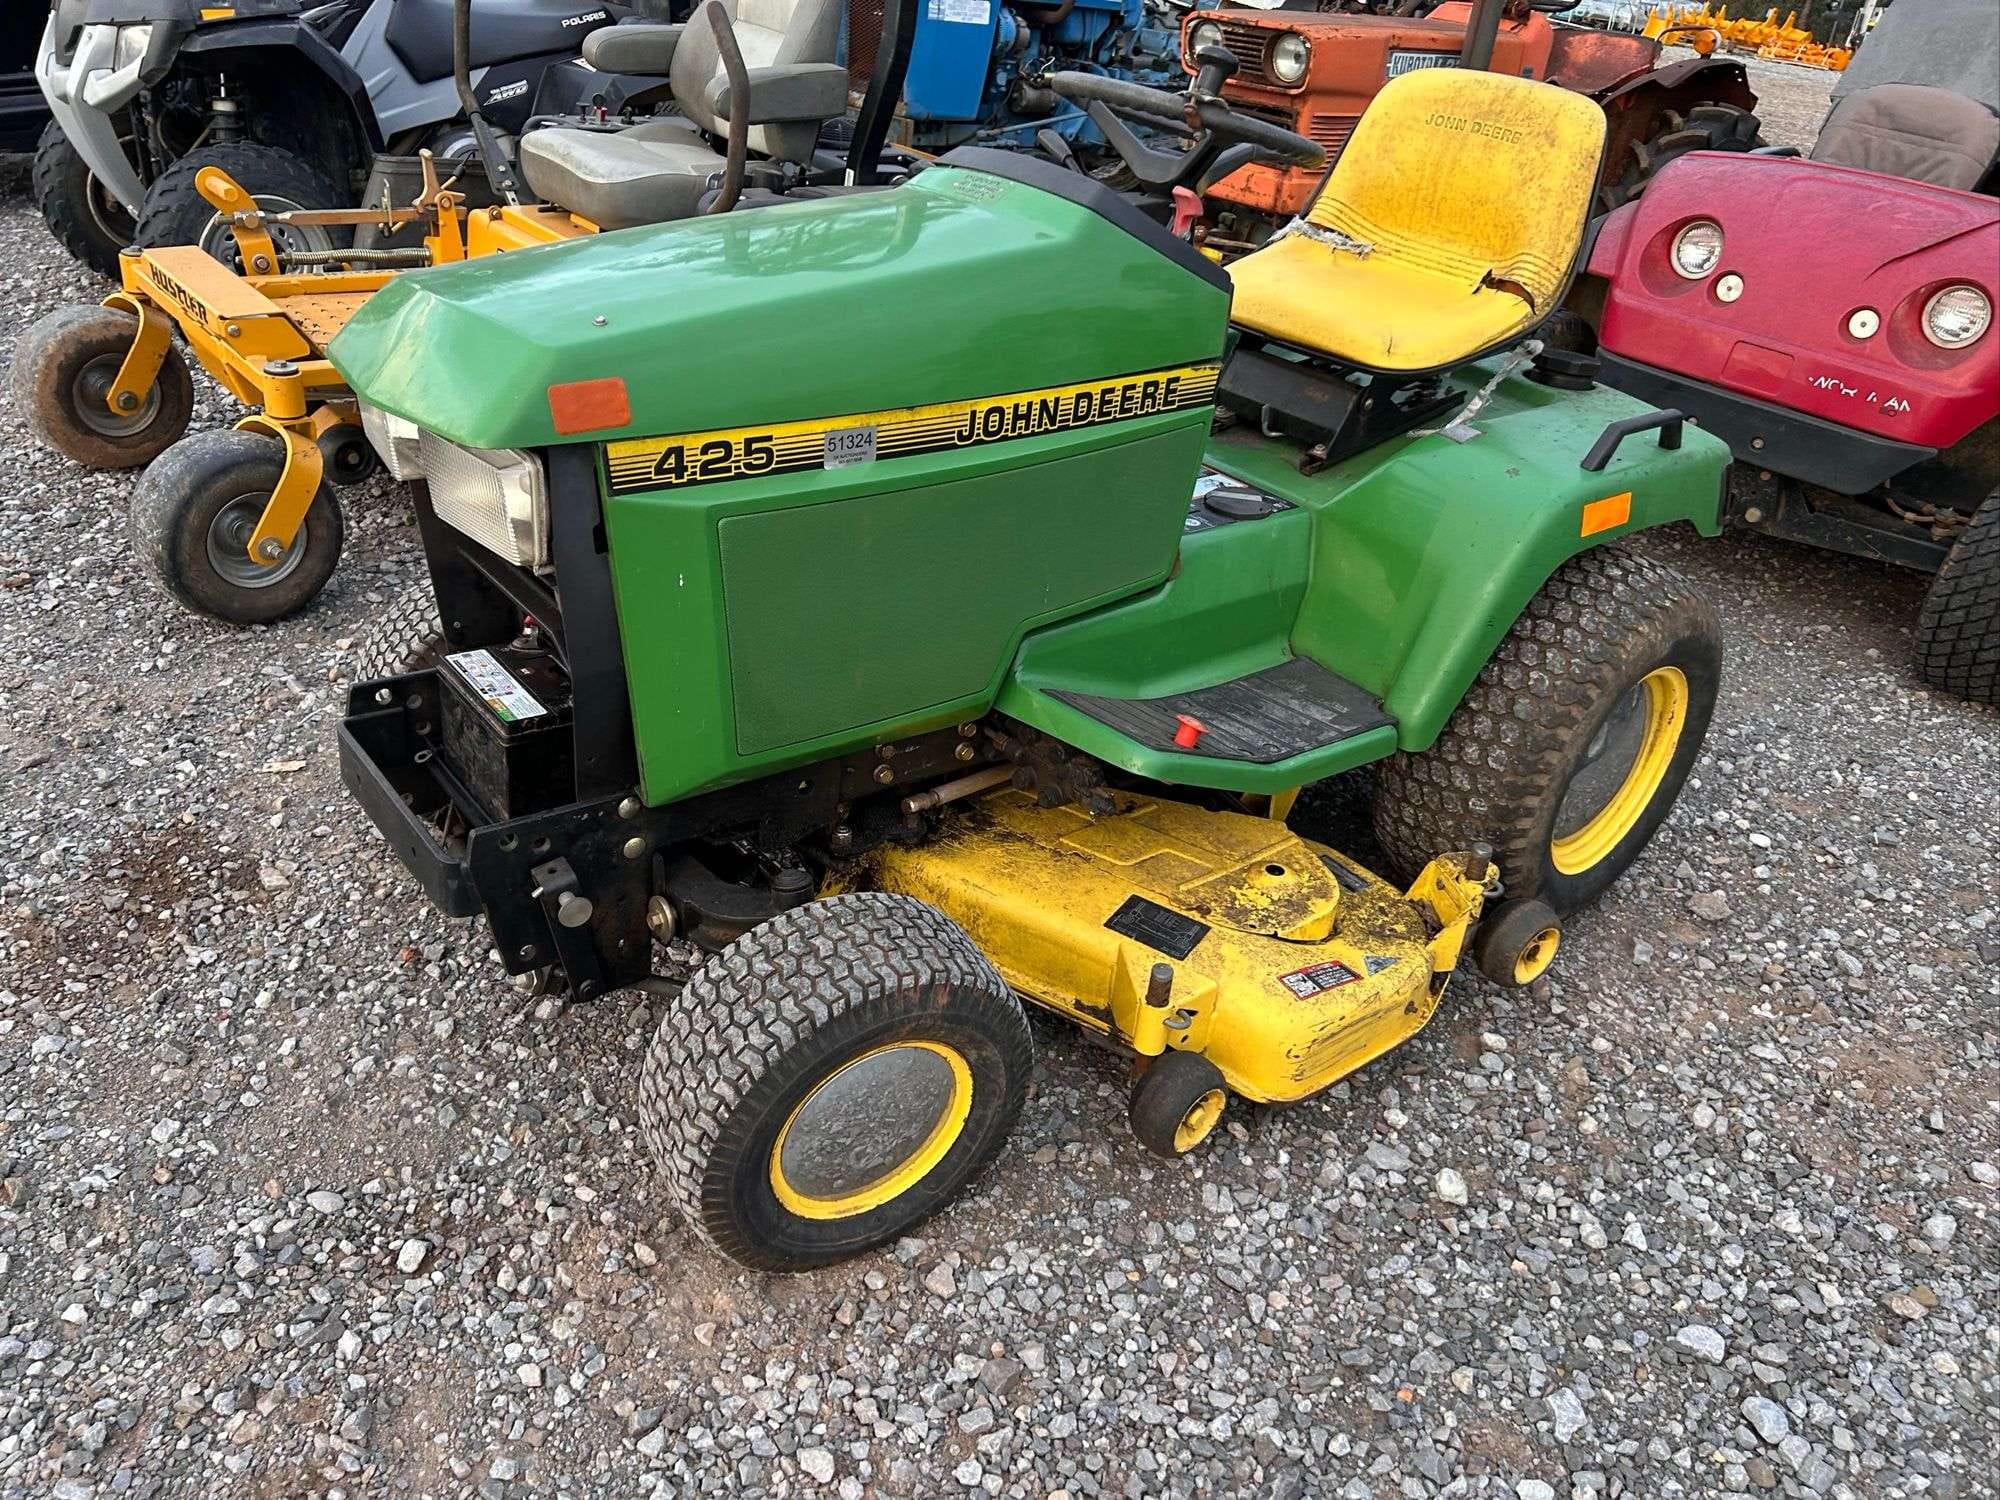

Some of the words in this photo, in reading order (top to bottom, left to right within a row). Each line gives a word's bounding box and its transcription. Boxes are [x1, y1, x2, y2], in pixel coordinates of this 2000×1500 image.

[561, 11, 606, 28] POLARIS
[1425, 113, 1467, 131] JOHN
[1470, 121, 1522, 145] DEERE
[149, 262, 208, 325] HUSTLER
[955, 396, 1061, 445] JOHN
[1070, 376, 1182, 426] DEERE
[652, 434, 776, 483] 425
[827, 431, 873, 453] 51324
